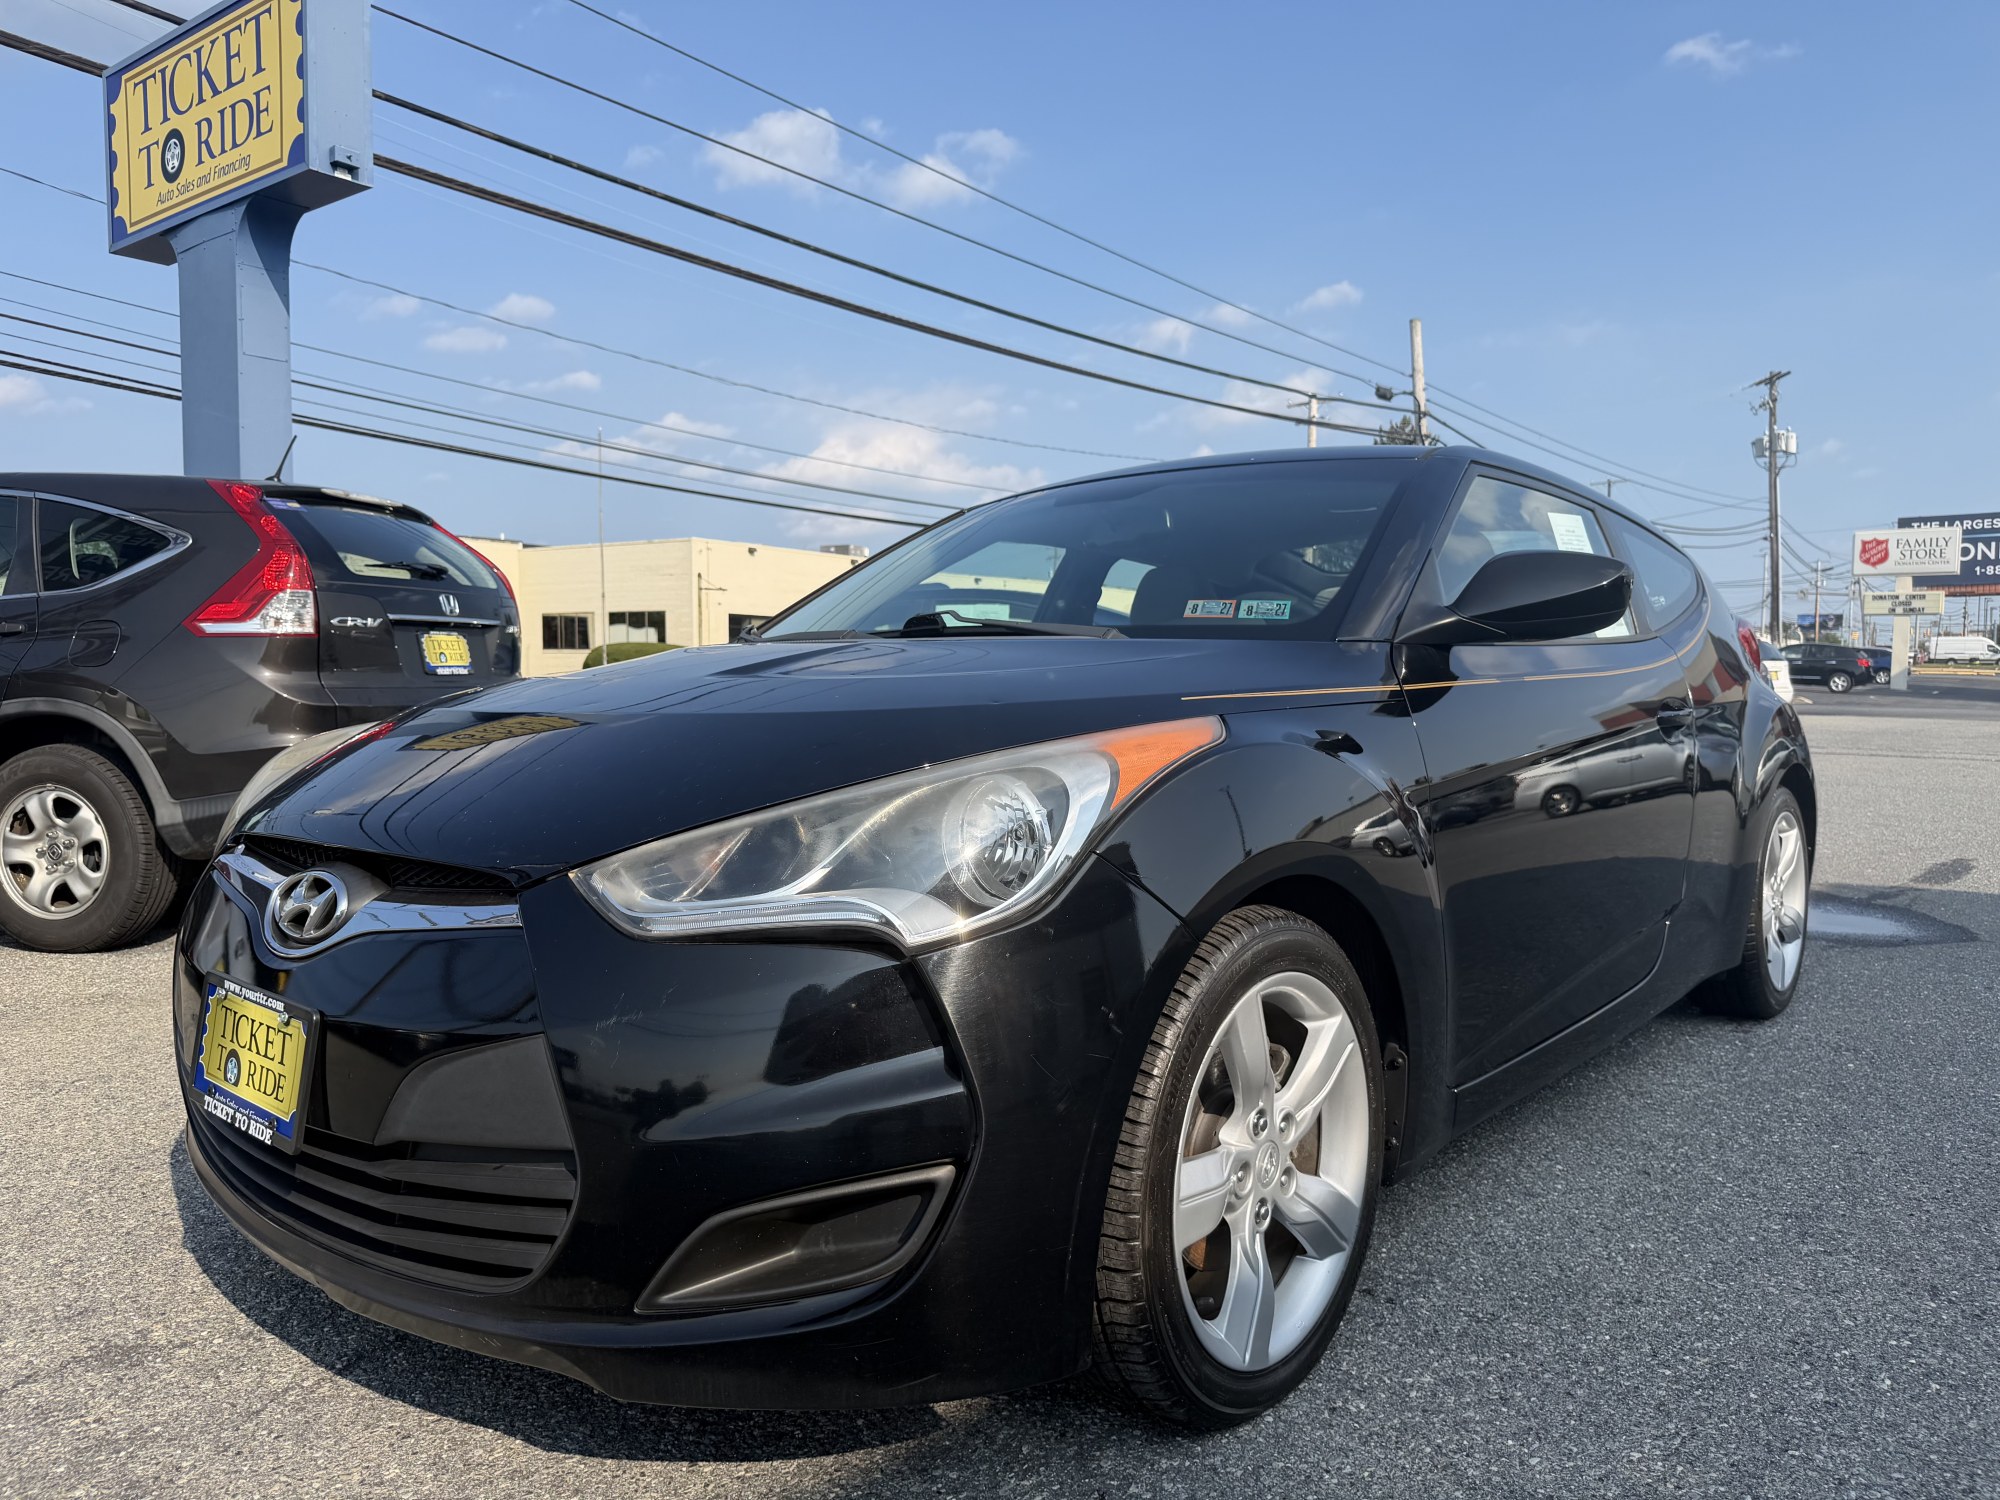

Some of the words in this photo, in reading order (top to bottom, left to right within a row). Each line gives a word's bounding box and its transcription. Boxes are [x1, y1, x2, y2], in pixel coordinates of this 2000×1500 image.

[133, 4, 272, 136] TICKET
[195, 85, 274, 168] RIDE
[156, 189, 174, 207] Auto
[175, 178, 195, 198] Sales
[196, 167, 212, 187] and
[213, 153, 251, 181] Financing
[1896, 536, 1952, 549] FAMILY
[1899, 548, 1947, 560] STORE
[1190, 603, 1199, 615] 8
[1220, 602, 1233, 616] 27
[1246, 605, 1254, 616] 8
[1274, 603, 1287, 616] 27
[330, 616, 384, 628] CR-V
[430, 639, 462, 651] TICKET
[448, 652, 466, 662] RIDE
[224, 979, 285, 1012] www.yourttr.com
[220, 1004, 293, 1067] TICKET
[245, 1059, 287, 1104] RIDE
[204, 1094, 235, 1123] TICKET
[235, 1112, 249, 1131] TO
[248, 1119, 273, 1146] RIDE
